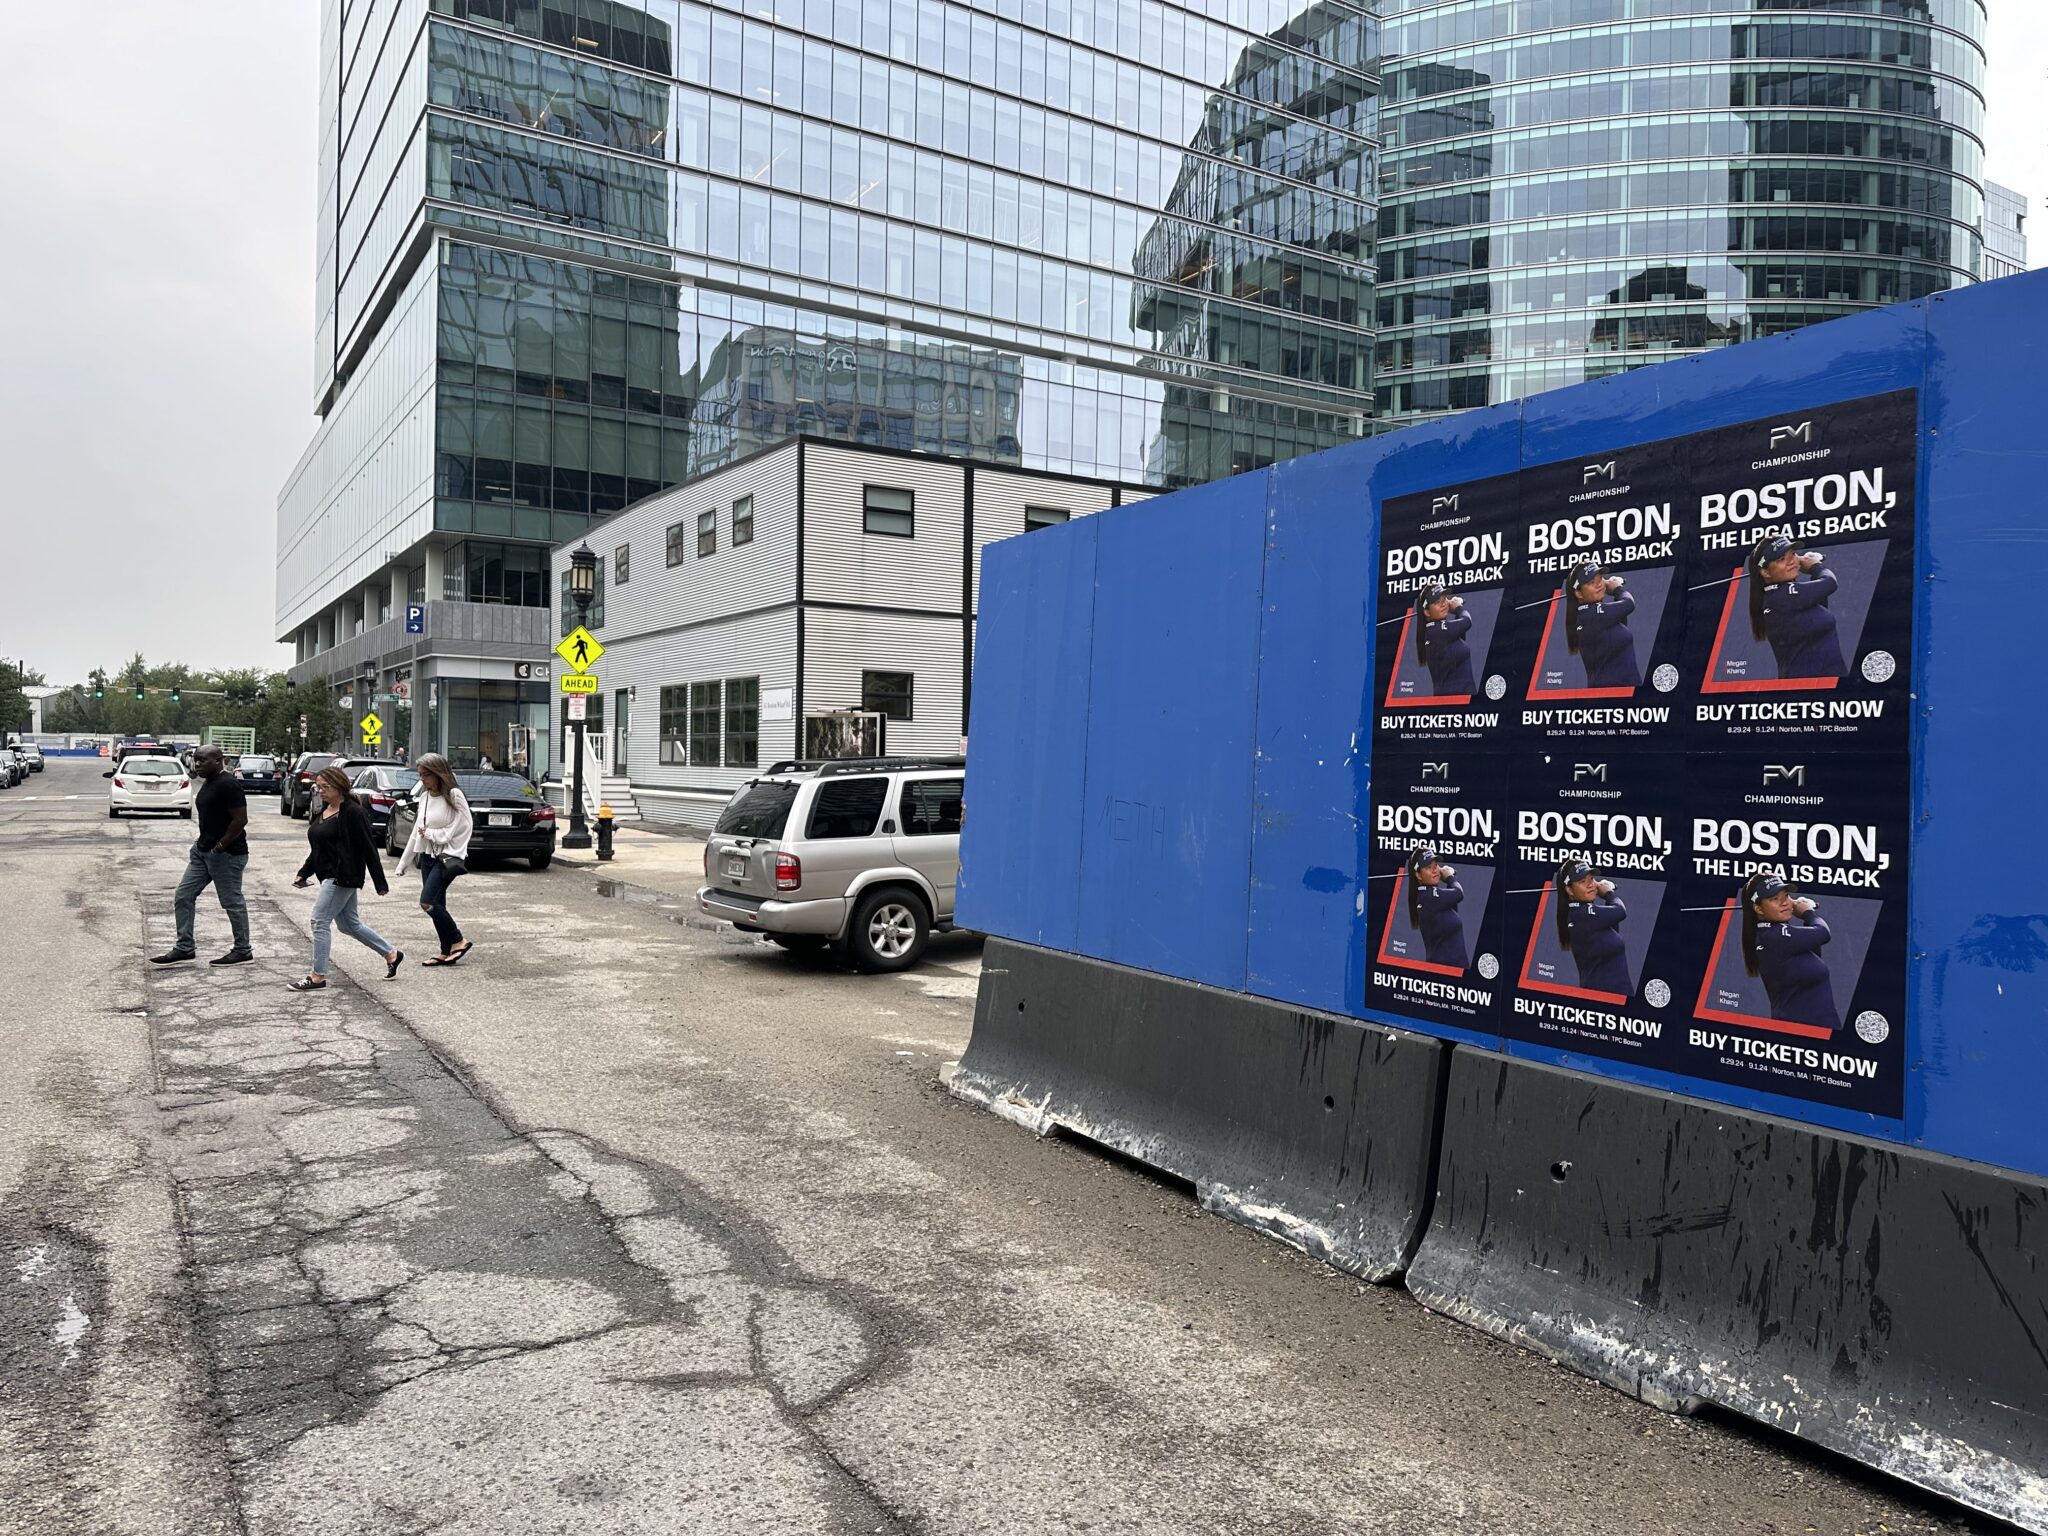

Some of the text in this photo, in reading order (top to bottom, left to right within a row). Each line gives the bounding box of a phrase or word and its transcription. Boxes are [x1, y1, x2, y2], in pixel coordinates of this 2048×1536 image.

[1751, 448, 1831, 470] CHAMPIONSHIP
[1569, 485, 1631, 503] CHAMPIONSHIP
[1700, 466, 1896, 529] BOSTON,
[1420, 516, 1470, 531] CHAMPIONSHIP
[1528, 502, 1681, 554] BOSTON,
[1700, 530, 1737, 551] THE
[1797, 519, 1821, 539] IS
[1824, 509, 1887, 535] BACK
[1386, 531, 1510, 577] BOSTON,
[1528, 556, 1557, 574] THE
[1604, 547, 1623, 564] IS
[1625, 540, 1673, 562] BACK
[1386, 578, 1410, 594] THE
[1448, 571, 1463, 586] IS
[1464, 565, 1504, 584] BACK
[410, 608, 421, 620] P
[1726, 660, 1747, 668] Megan
[565, 679, 594, 689] AHEAD
[1381, 713, 1499, 729] BUY TICKETS NOW
[1523, 707, 1670, 725] BUY TICKETS NOW
[1696, 699, 1884, 721] BUY TICKETS NOW
[1727, 726, 1751, 734] 8.29.24
[1410, 785, 1460, 794] CHAMPIONSHIP
[1559, 789, 1622, 799] CHAMPIONSHIP
[1744, 794, 1824, 805] CHAMPIONSHIP
[1377, 805, 1500, 844] BOSTON,
[1518, 810, 1672, 856] BOSTON,
[1377, 836, 1401, 851] THE
[1439, 840, 1454, 855] IS
[1455, 841, 1494, 858] BACK
[1693, 818, 1890, 870] BOSTON,
[1518, 845, 1548, 862] THE
[1595, 851, 1614, 867] IS
[1616, 852, 1665, 872] BACK
[1692, 857, 1730, 876] THE
[1791, 864, 1814, 883] IS
[1818, 866, 1880, 888] BACK
[1373, 971, 1492, 1007] BUY TICKETS NOW
[1719, 989, 1740, 999] Megan
[1719, 997, 1739, 1008] Khang
[1514, 997, 1662, 1039] BUY TICKETS NOW
[1623, 1038, 1642, 1047] Boston
[1688, 1028, 1878, 1079] BUY TICKETS NOW
[1720, 1056, 1852, 1088] 8.29.24 9.1.24 Norton, MA TPC Boston
